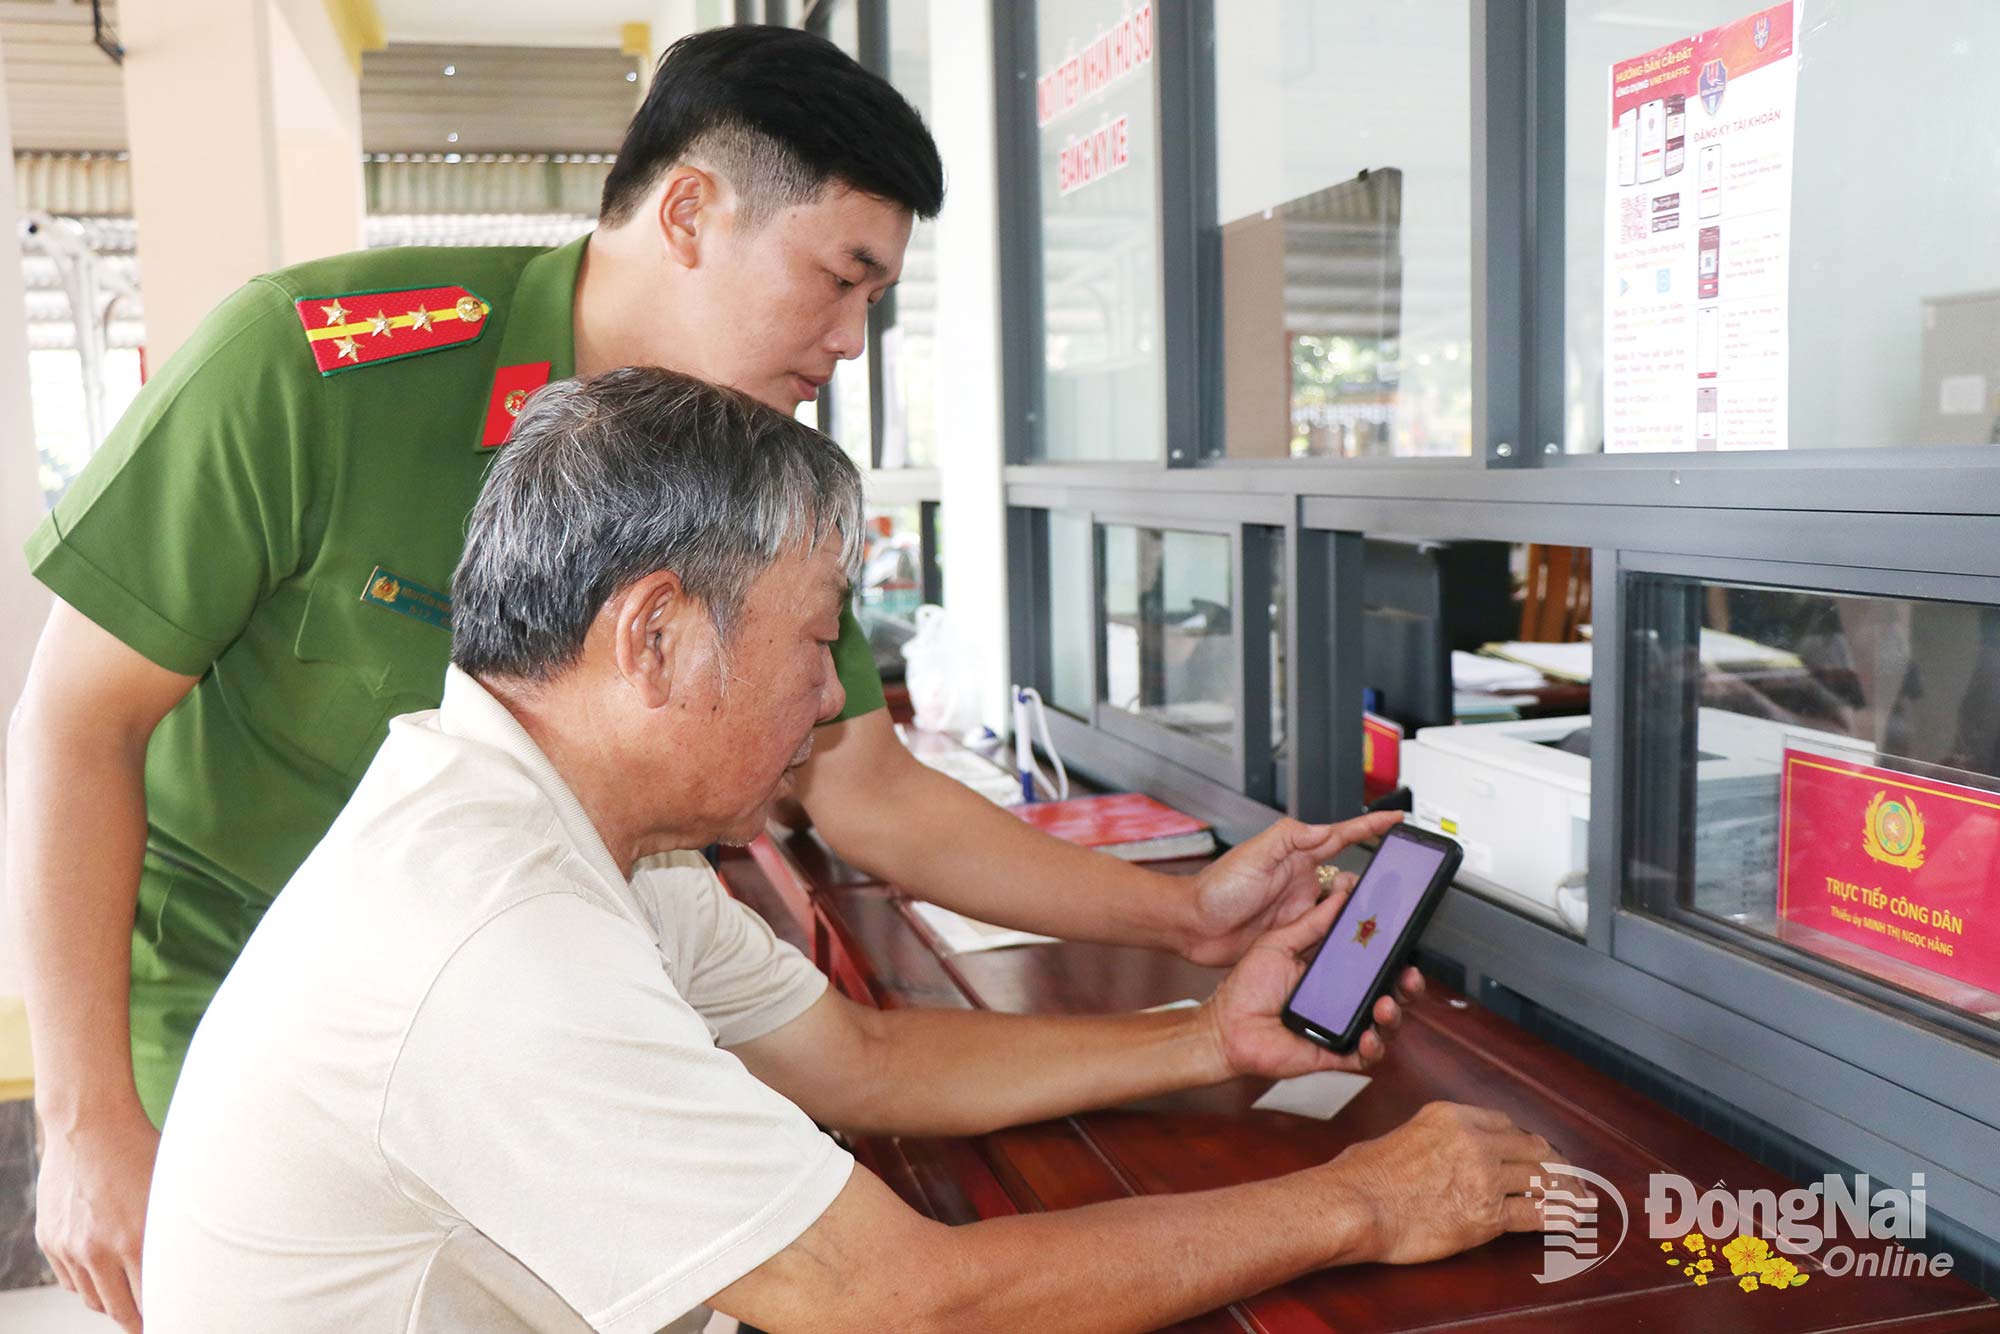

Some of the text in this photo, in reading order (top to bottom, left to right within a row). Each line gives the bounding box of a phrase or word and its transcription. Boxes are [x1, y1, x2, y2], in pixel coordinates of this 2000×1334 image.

[1825, 876, 1963, 935] TRỰC TIẾP CÔNG DÂN
[1863, 916, 1886, 934] MINH
[1902, 928, 1926, 948] NGỌC
